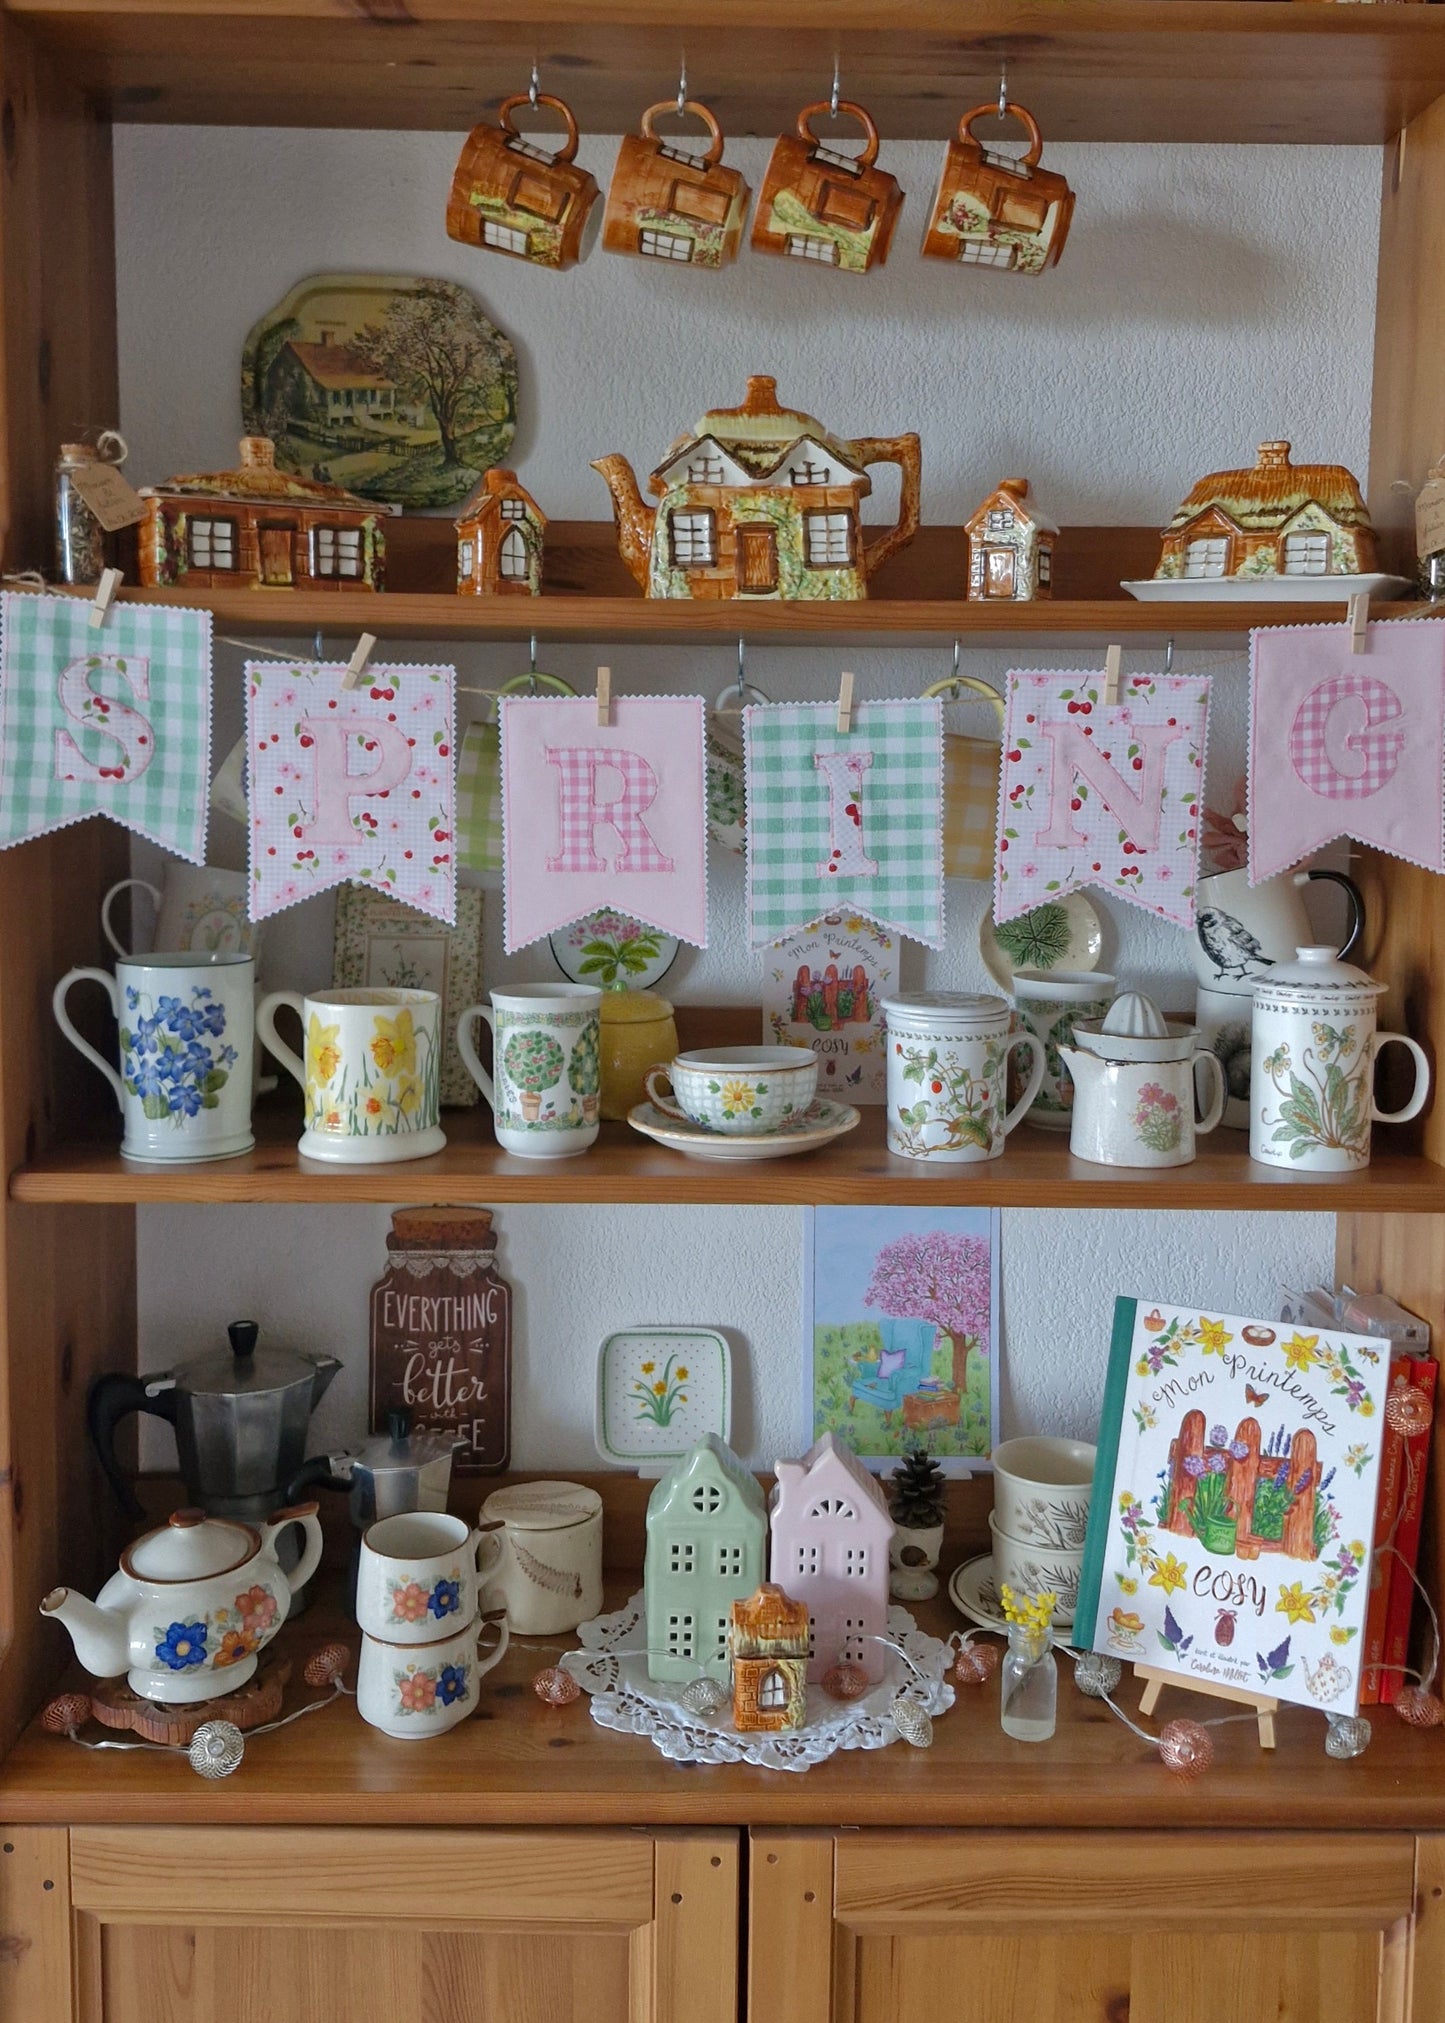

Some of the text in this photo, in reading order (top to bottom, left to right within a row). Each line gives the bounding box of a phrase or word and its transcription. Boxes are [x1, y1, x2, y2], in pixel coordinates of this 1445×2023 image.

[789, 933, 878, 968] Mon Printemps
[384, 1288, 498, 1333] EVERYTHING
[428, 1336, 461, 1358] gets
[392, 1352, 488, 1409] better
[1152, 1353, 1337, 1436] Mon Printemps
[429, 1407, 458, 1419] with
